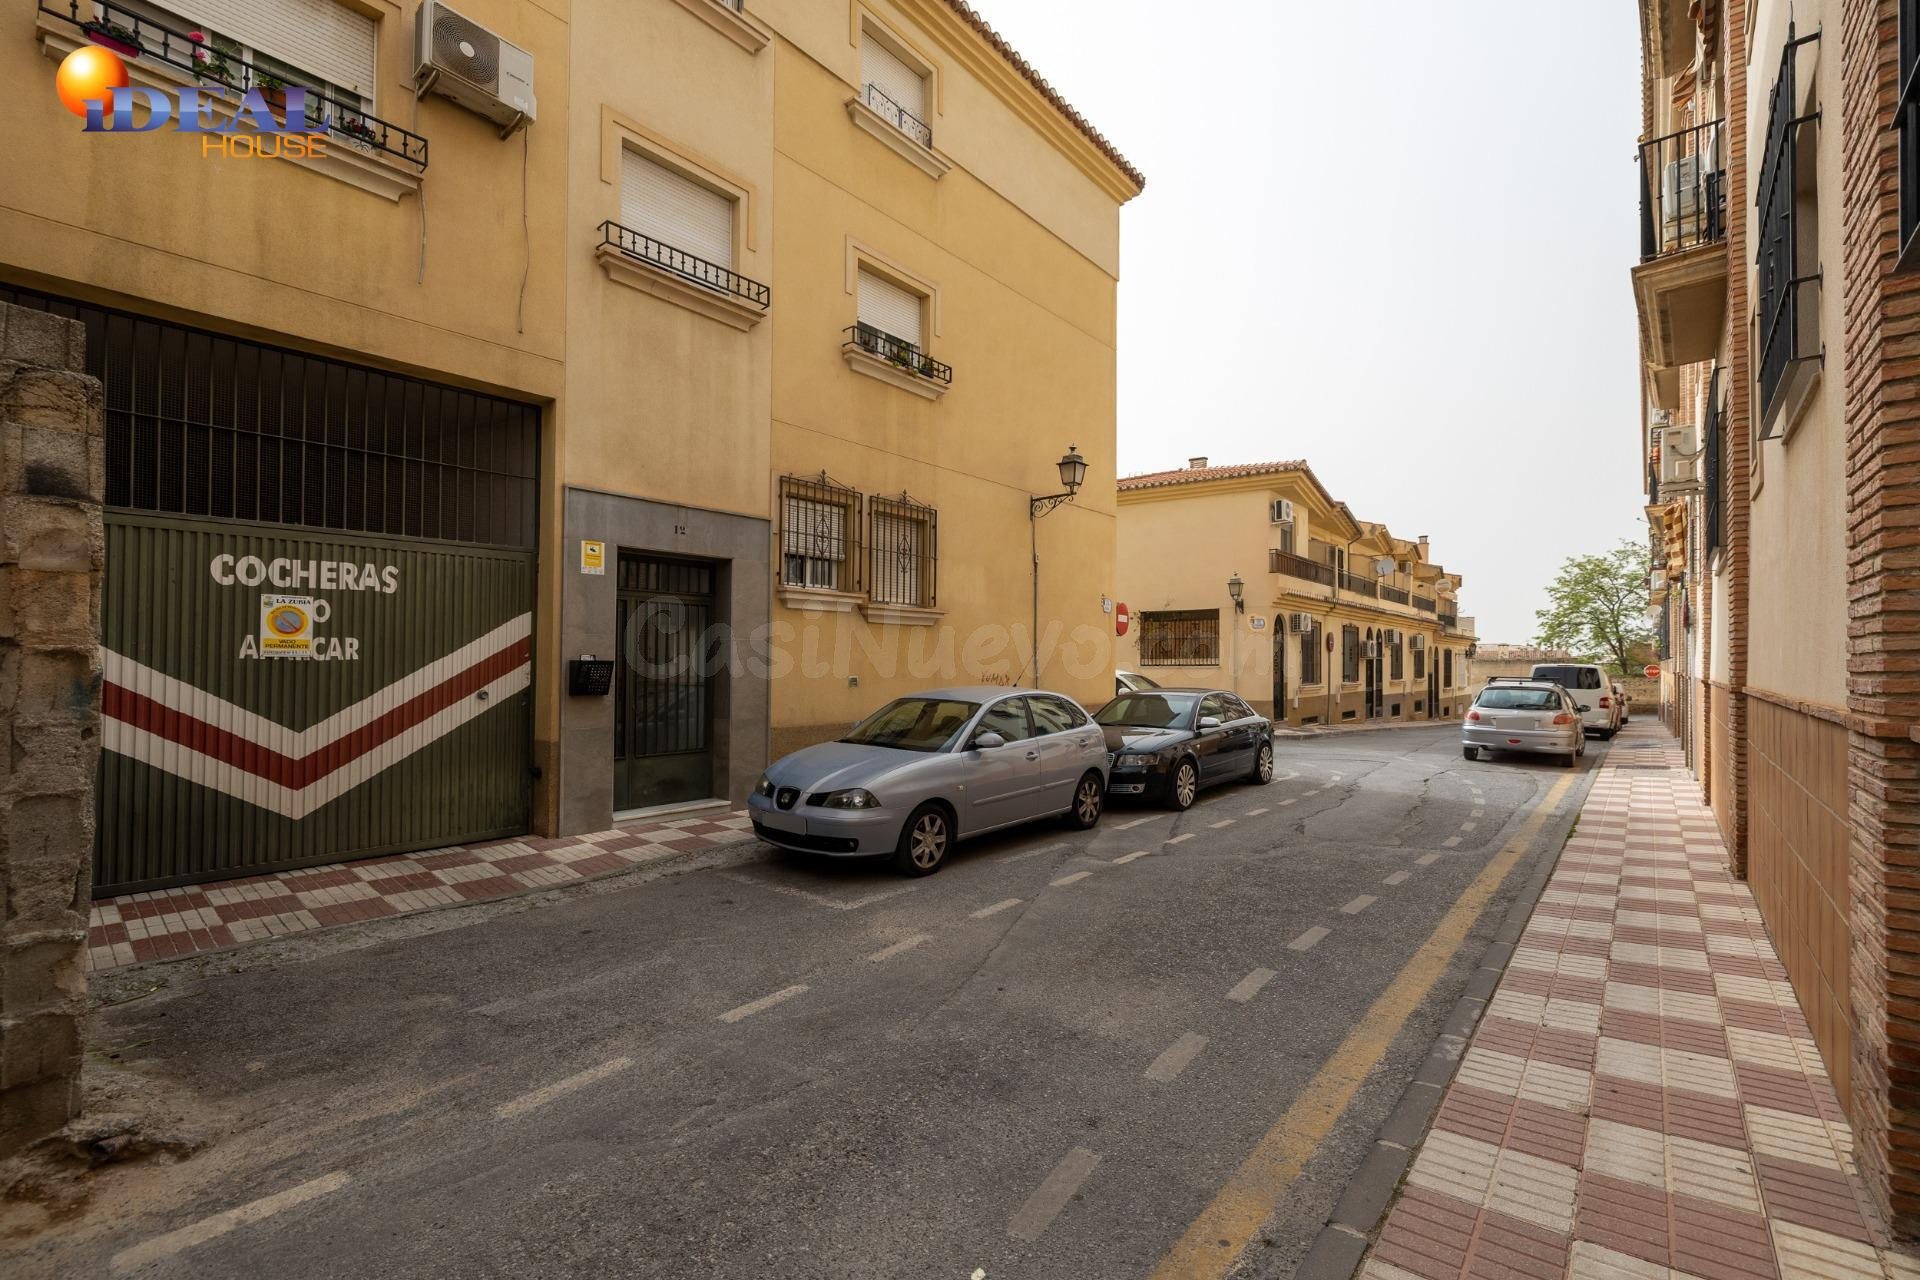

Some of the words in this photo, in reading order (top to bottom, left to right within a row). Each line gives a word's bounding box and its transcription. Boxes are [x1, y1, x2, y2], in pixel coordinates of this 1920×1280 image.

[674, 525, 686, 534] 12
[210, 553, 399, 594] COCHERAS
[239, 634, 359, 661] ACAR
